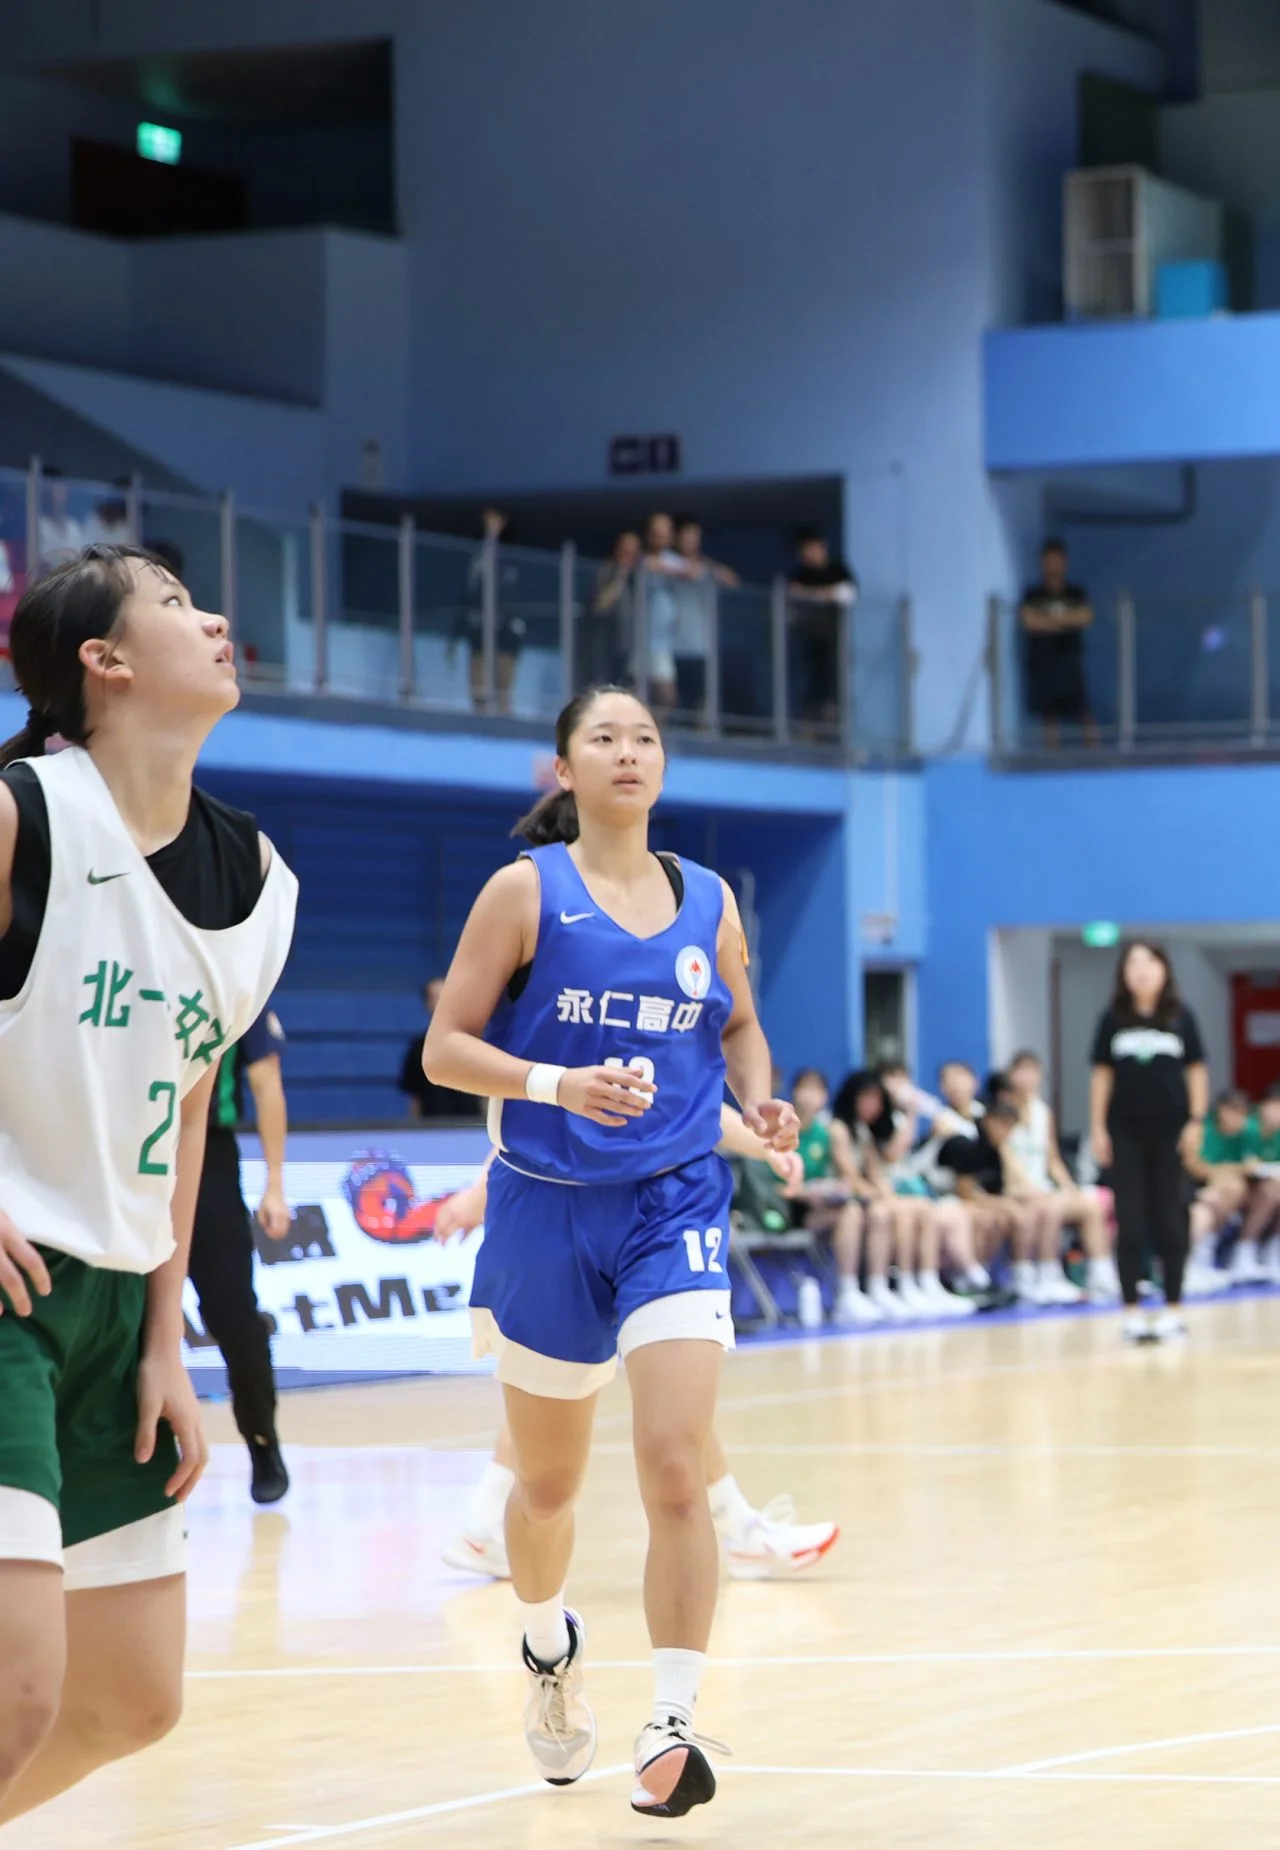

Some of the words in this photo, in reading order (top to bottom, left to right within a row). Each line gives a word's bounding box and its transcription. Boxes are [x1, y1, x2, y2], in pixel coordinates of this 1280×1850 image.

[557, 988, 703, 1033] 永仁高中
[138, 1081, 176, 1175] 2
[683, 1227, 723, 1273] 12
